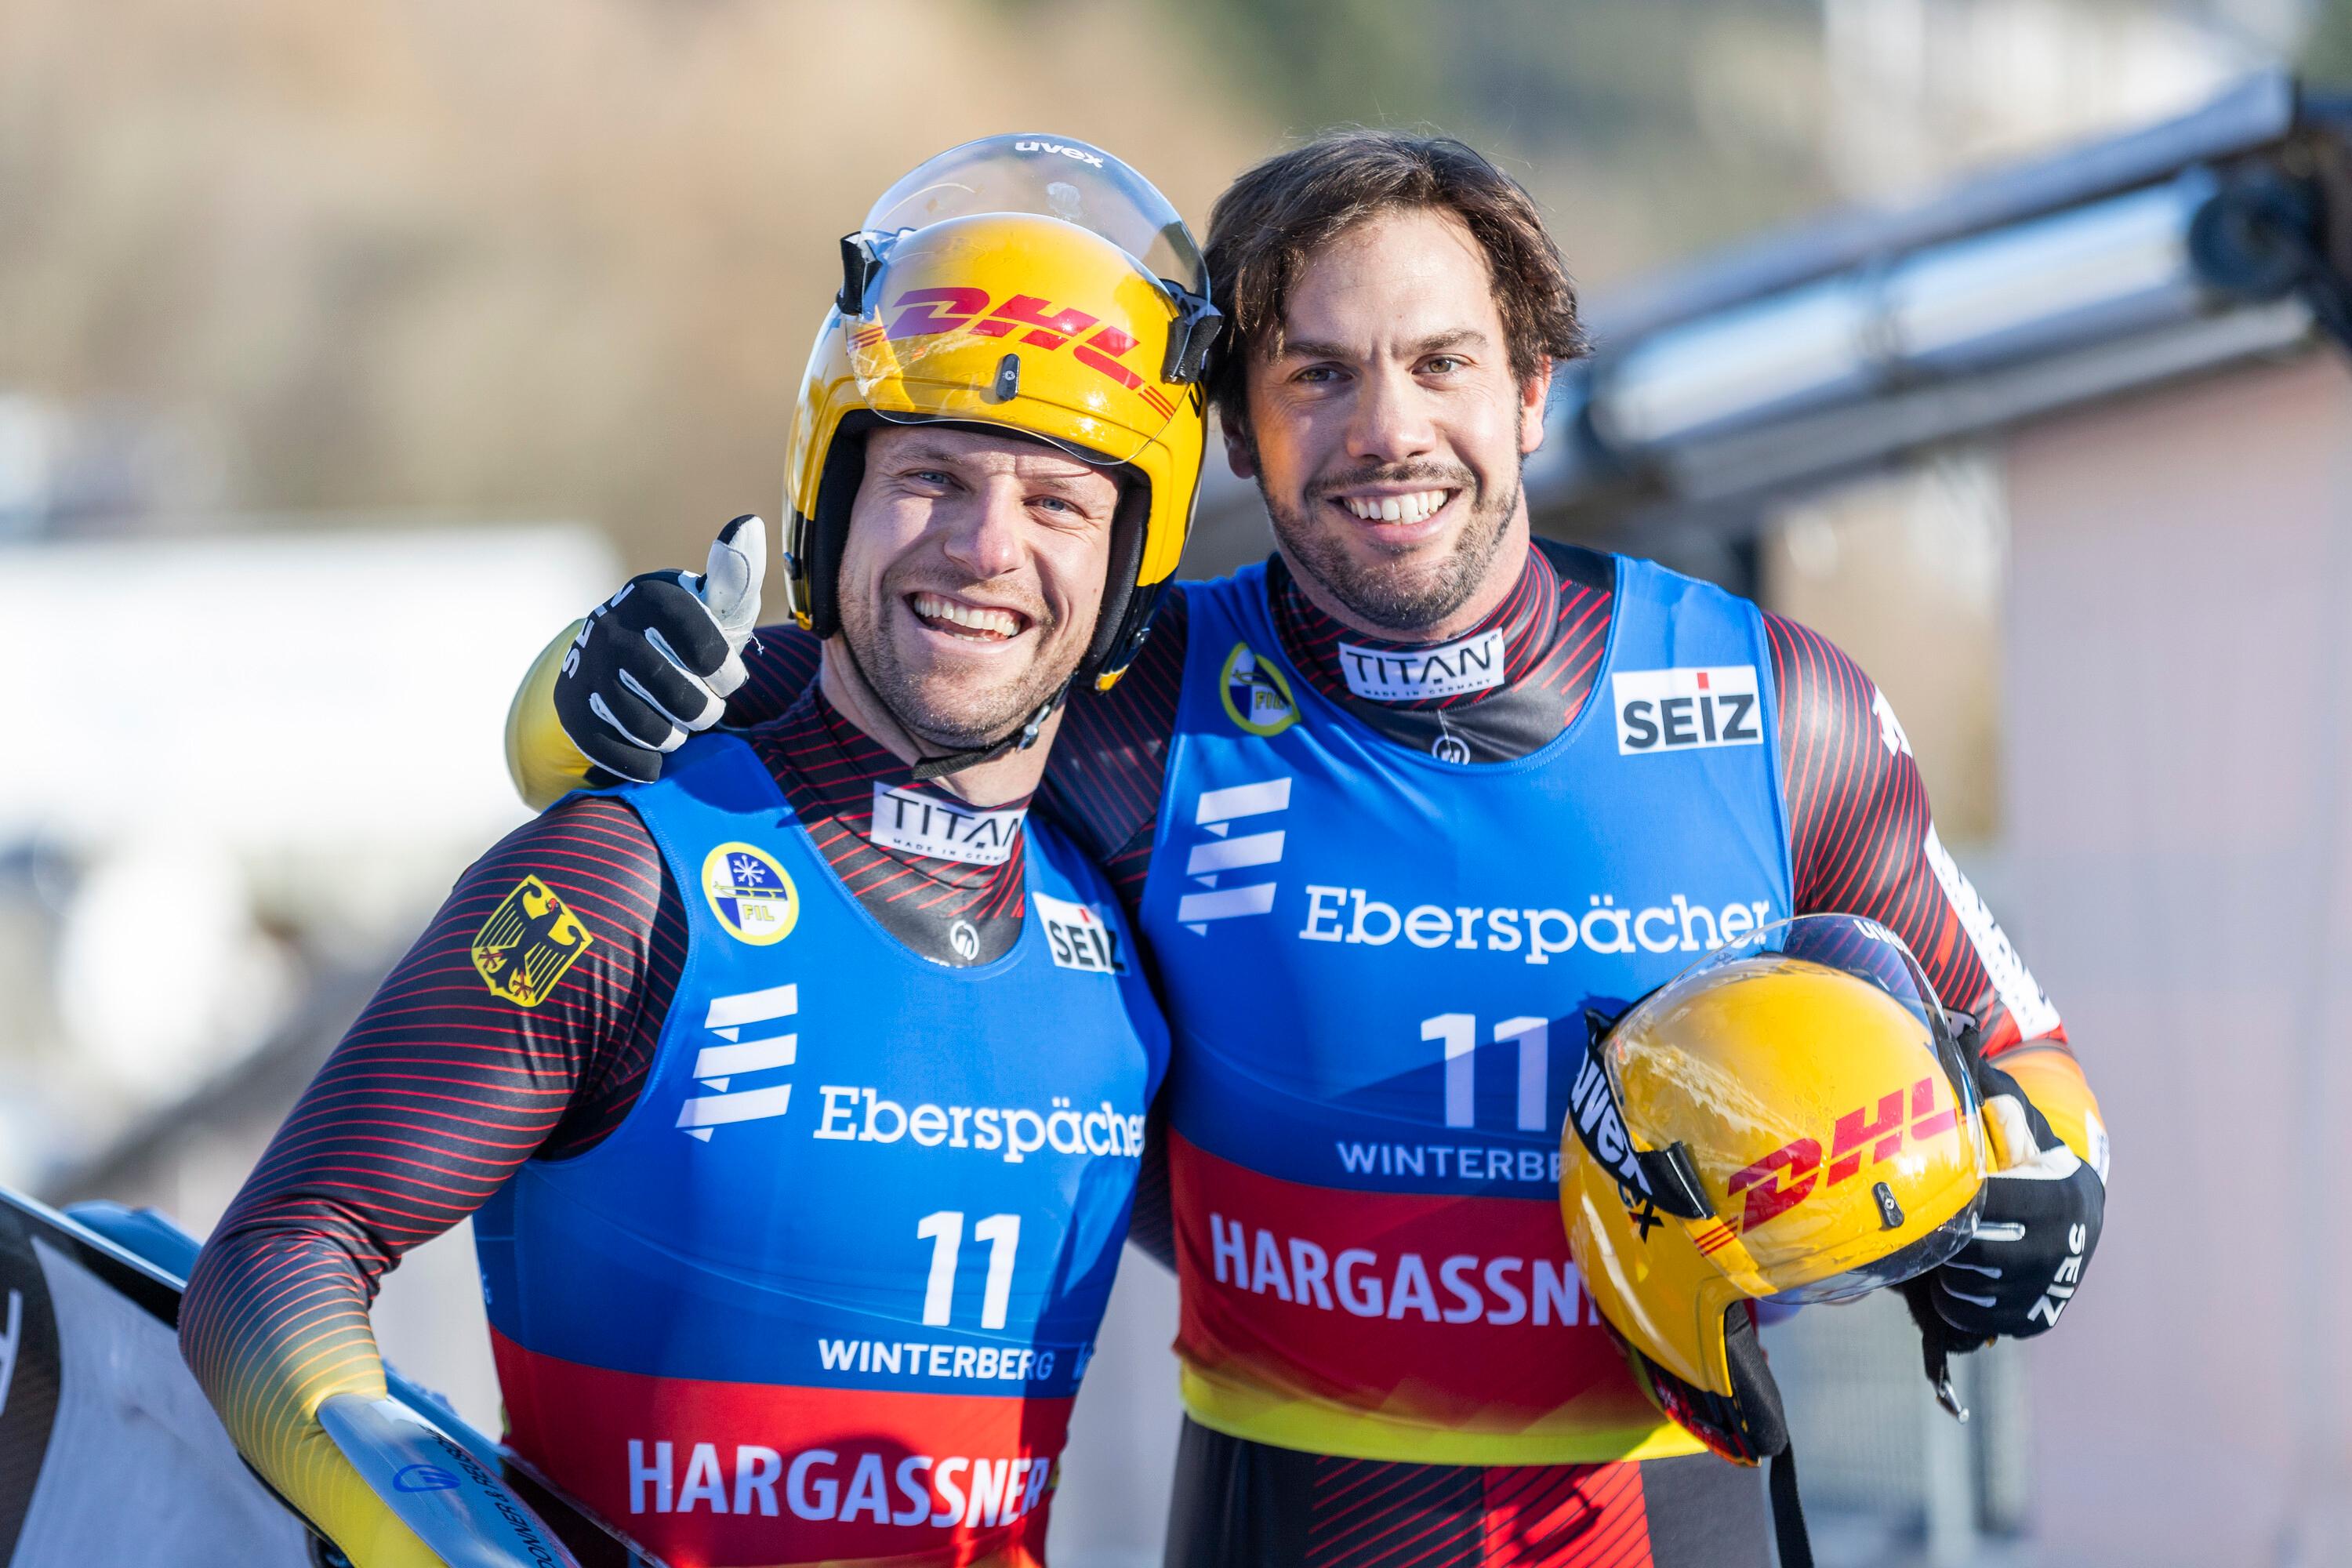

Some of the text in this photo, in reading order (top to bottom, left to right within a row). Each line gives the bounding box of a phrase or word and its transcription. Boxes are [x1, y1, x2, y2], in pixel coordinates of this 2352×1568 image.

[1015, 140, 1105, 169] uvex
[881, 286, 1141, 390] DHL
[1255, 691, 1285, 710] FIL
[1428, 677, 1491, 694] GERMANY
[1623, 672, 1758, 749] SEIZ
[893, 838, 933, 853] MADE
[742, 904, 775, 922] FIL
[1298, 884, 1769, 965] Eberspächer
[1420, 1012, 1549, 1132] 11
[1727, 1076, 1958, 1236] DHL
[916, 1210, 1022, 1330] 11
[1209, 1211, 1599, 1327] HARGASSN
[2026, 1222, 2086, 1327] SEIZ
[818, 1338, 1055, 1381] WINTERBERG
[628, 1439, 1051, 1528] HARGASSNER
